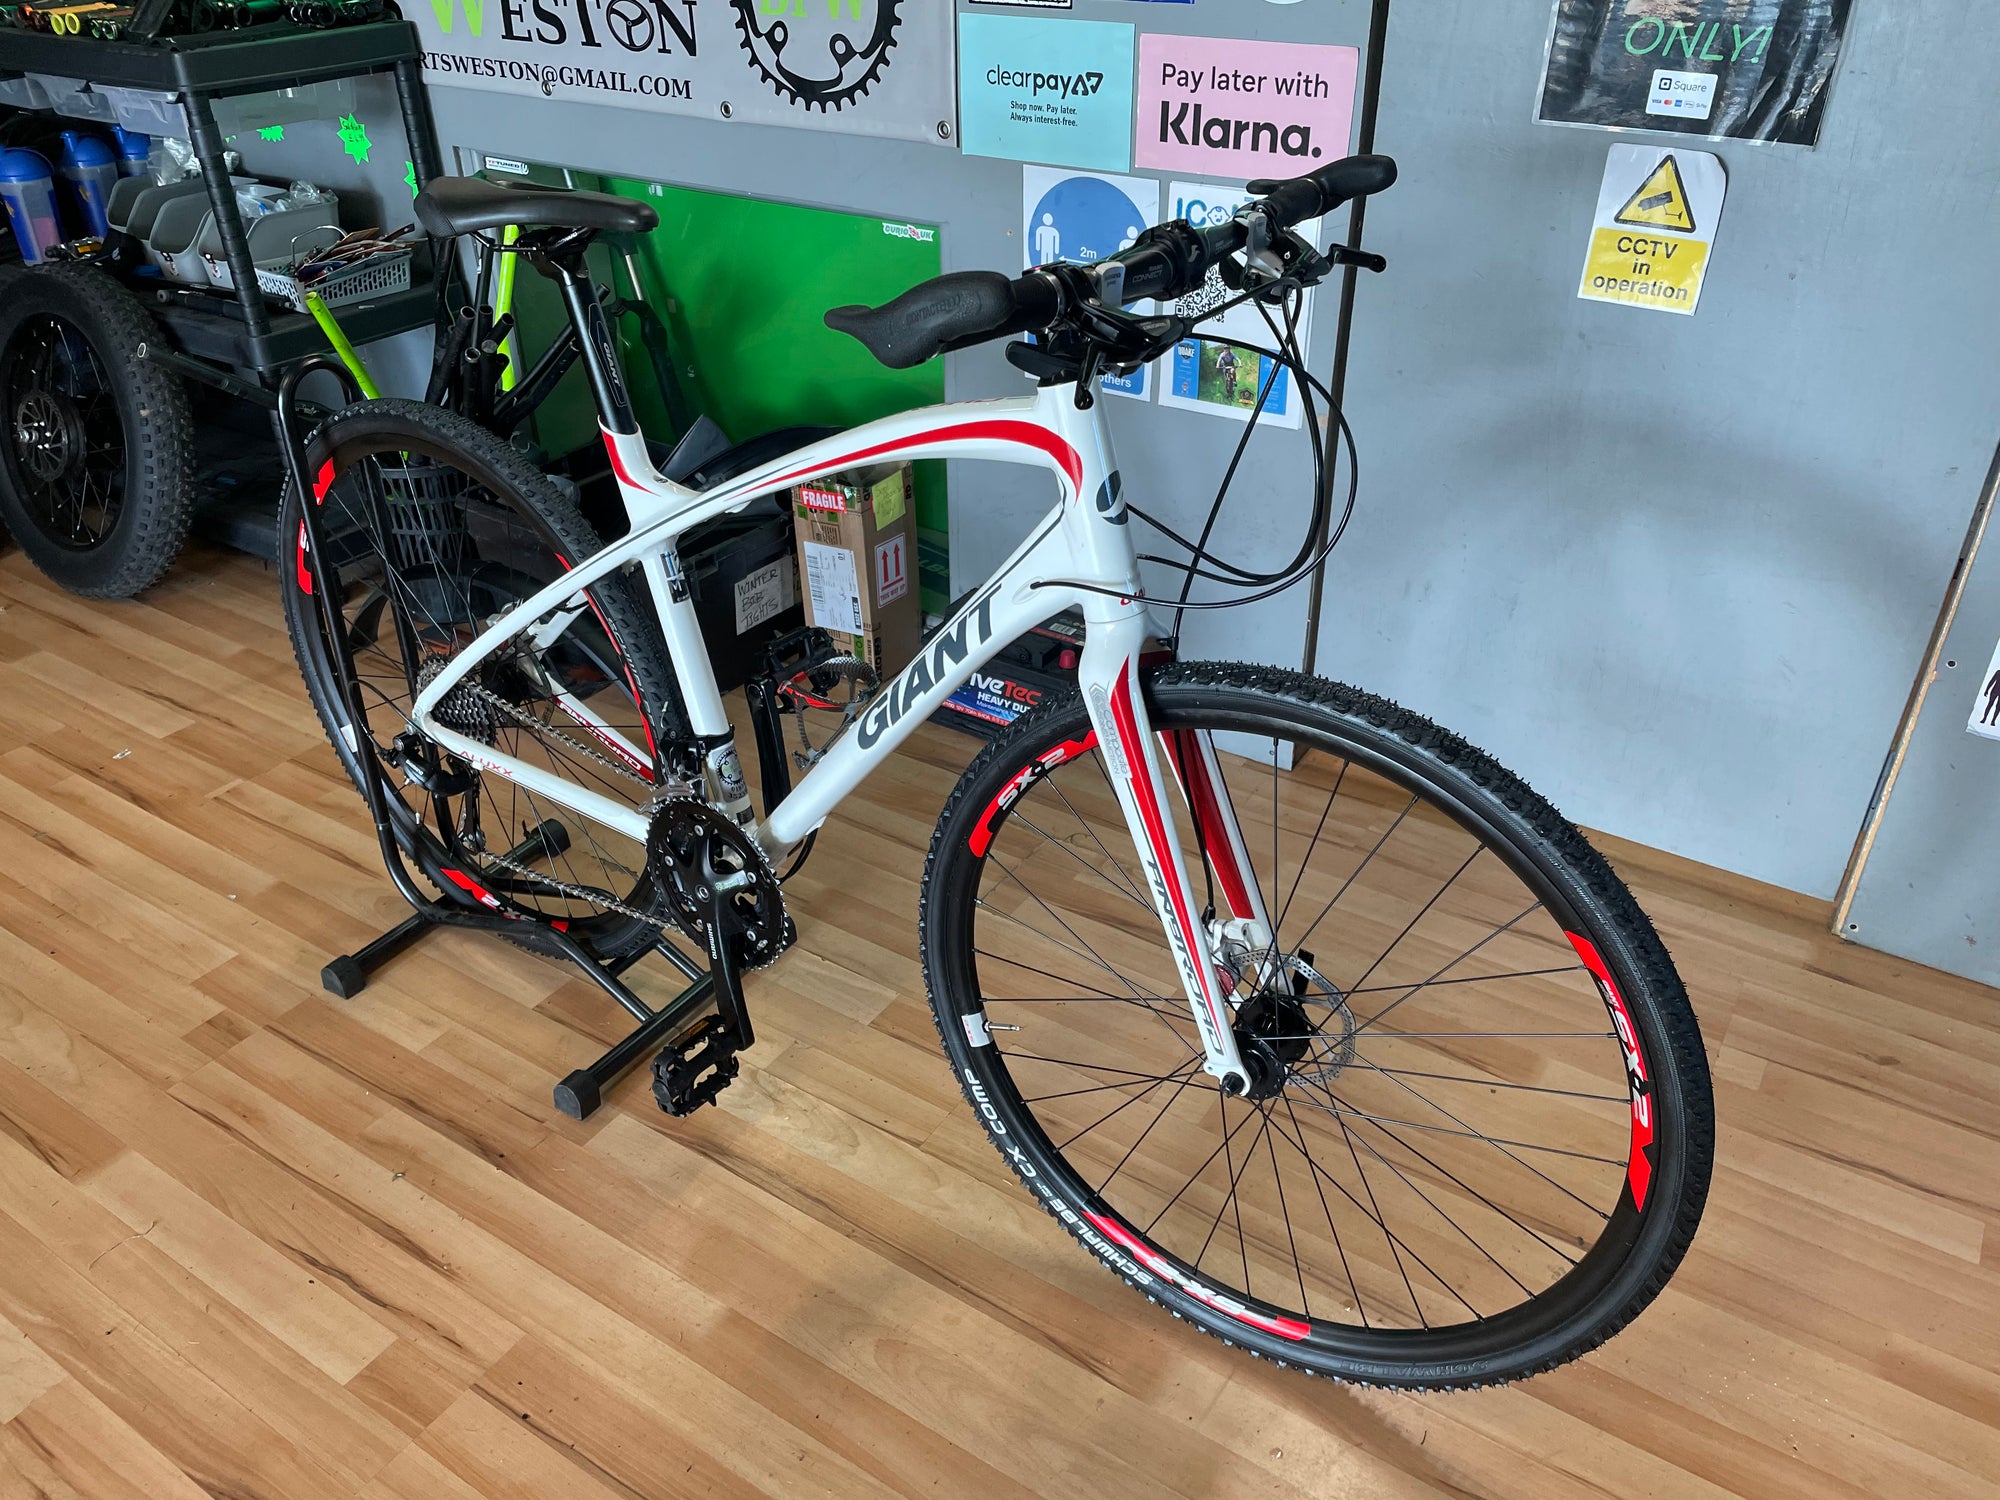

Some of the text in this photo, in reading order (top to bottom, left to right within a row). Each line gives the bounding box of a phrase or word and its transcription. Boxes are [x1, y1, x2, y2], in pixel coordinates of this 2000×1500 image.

[1624, 17, 1774, 64] ONLY!
[986, 64, 1072, 99] clearpay
[1161, 62, 1329, 98] Pay later with
[1673, 80, 1707, 92] Square
[1010, 100, 1078, 115] Shop now. Pay later.
[1010, 112, 1078, 127] Always interest-free.
[1159, 100, 1322, 158] Klarna.
[1080, 246, 1097, 259] 2m
[1616, 236, 1678, 259] CCTV
[1632, 258, 1651, 275] in
[1592, 275, 1688, 301] operation
[603, 341, 621, 387] GIANT
[1099, 372, 1132, 388] others
[801, 490, 845, 511] FRAGILE
[737, 568, 779, 596] WINTER
[857, 584, 1003, 750] GIANT
[977, 691, 1012, 709] HEAVY
[997, 747, 1068, 811] SX-2
[1608, 1005, 1649, 1129] SX-2
[964, 1068, 1154, 1285] SCHWALBE CX COMP
